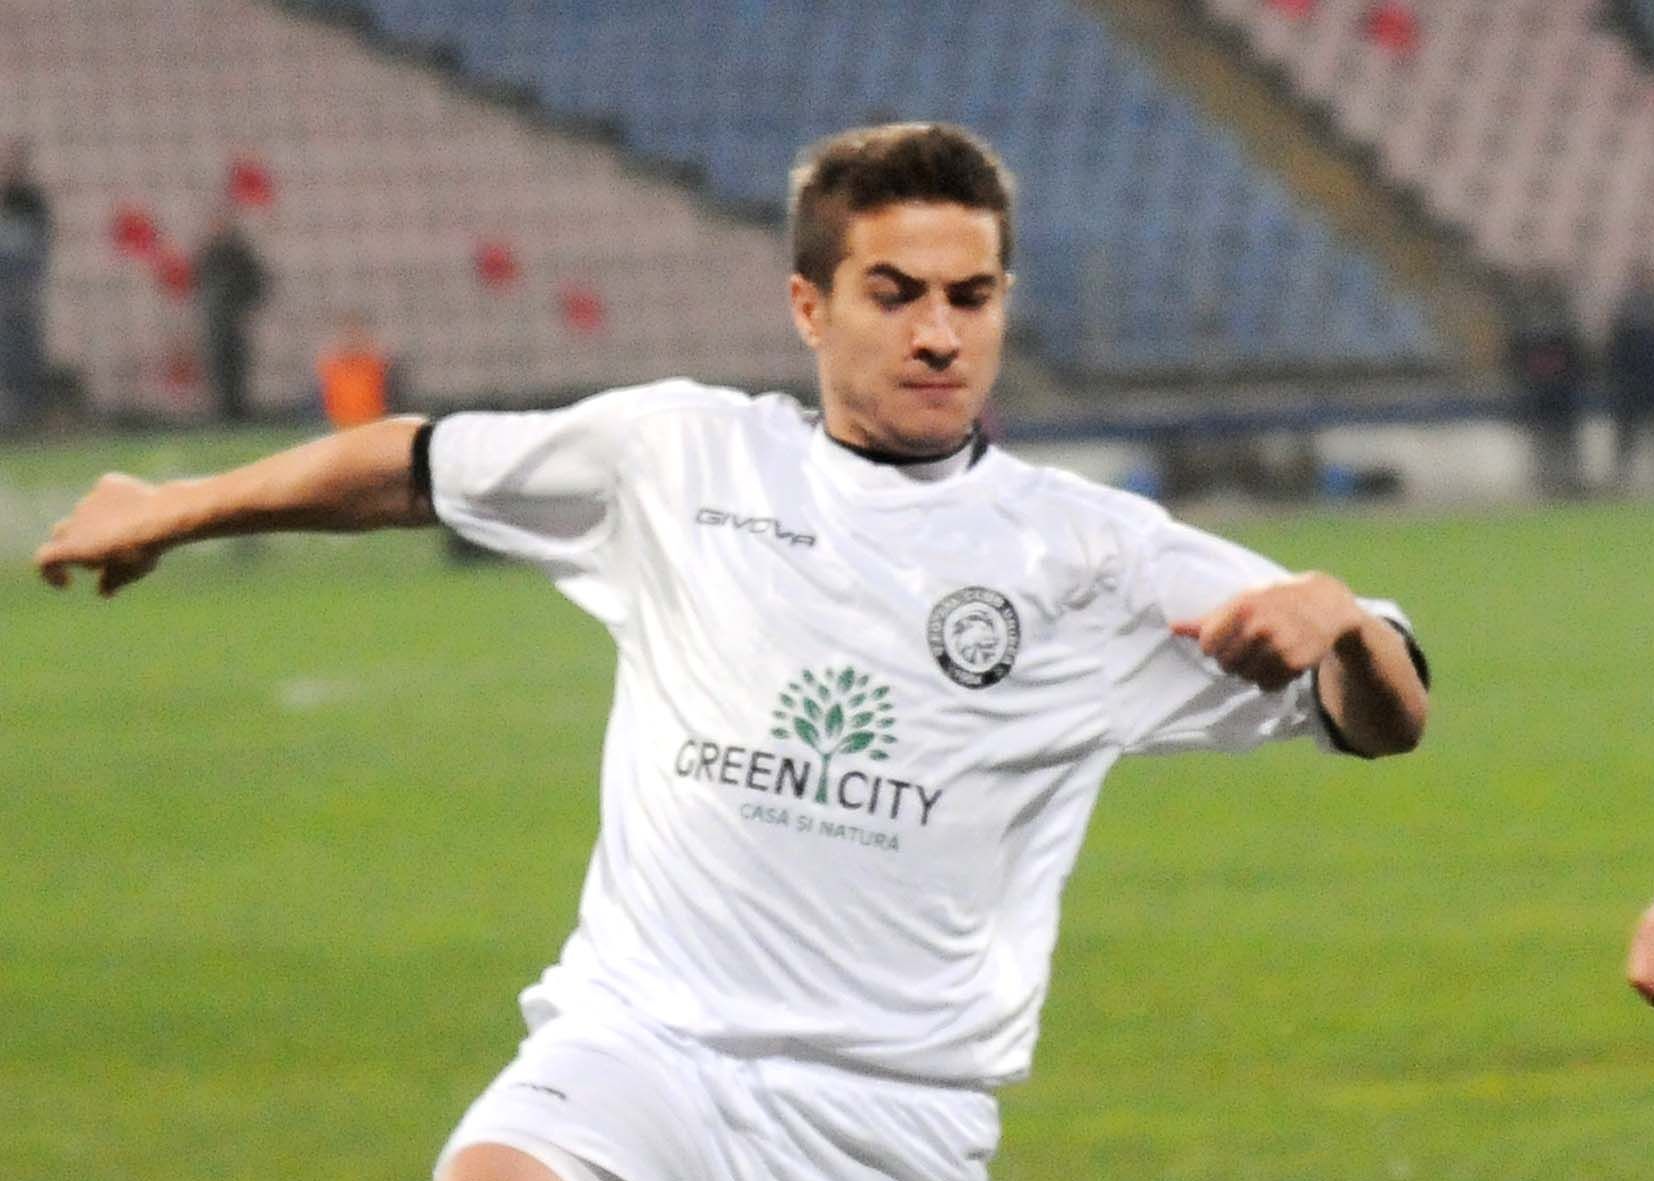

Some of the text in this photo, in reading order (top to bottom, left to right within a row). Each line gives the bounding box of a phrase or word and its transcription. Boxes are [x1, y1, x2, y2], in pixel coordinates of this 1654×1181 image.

[696, 508, 816, 546] GIVOVA
[676, 739, 942, 827] GREEN CITY
[740, 803, 789, 826] CASA
